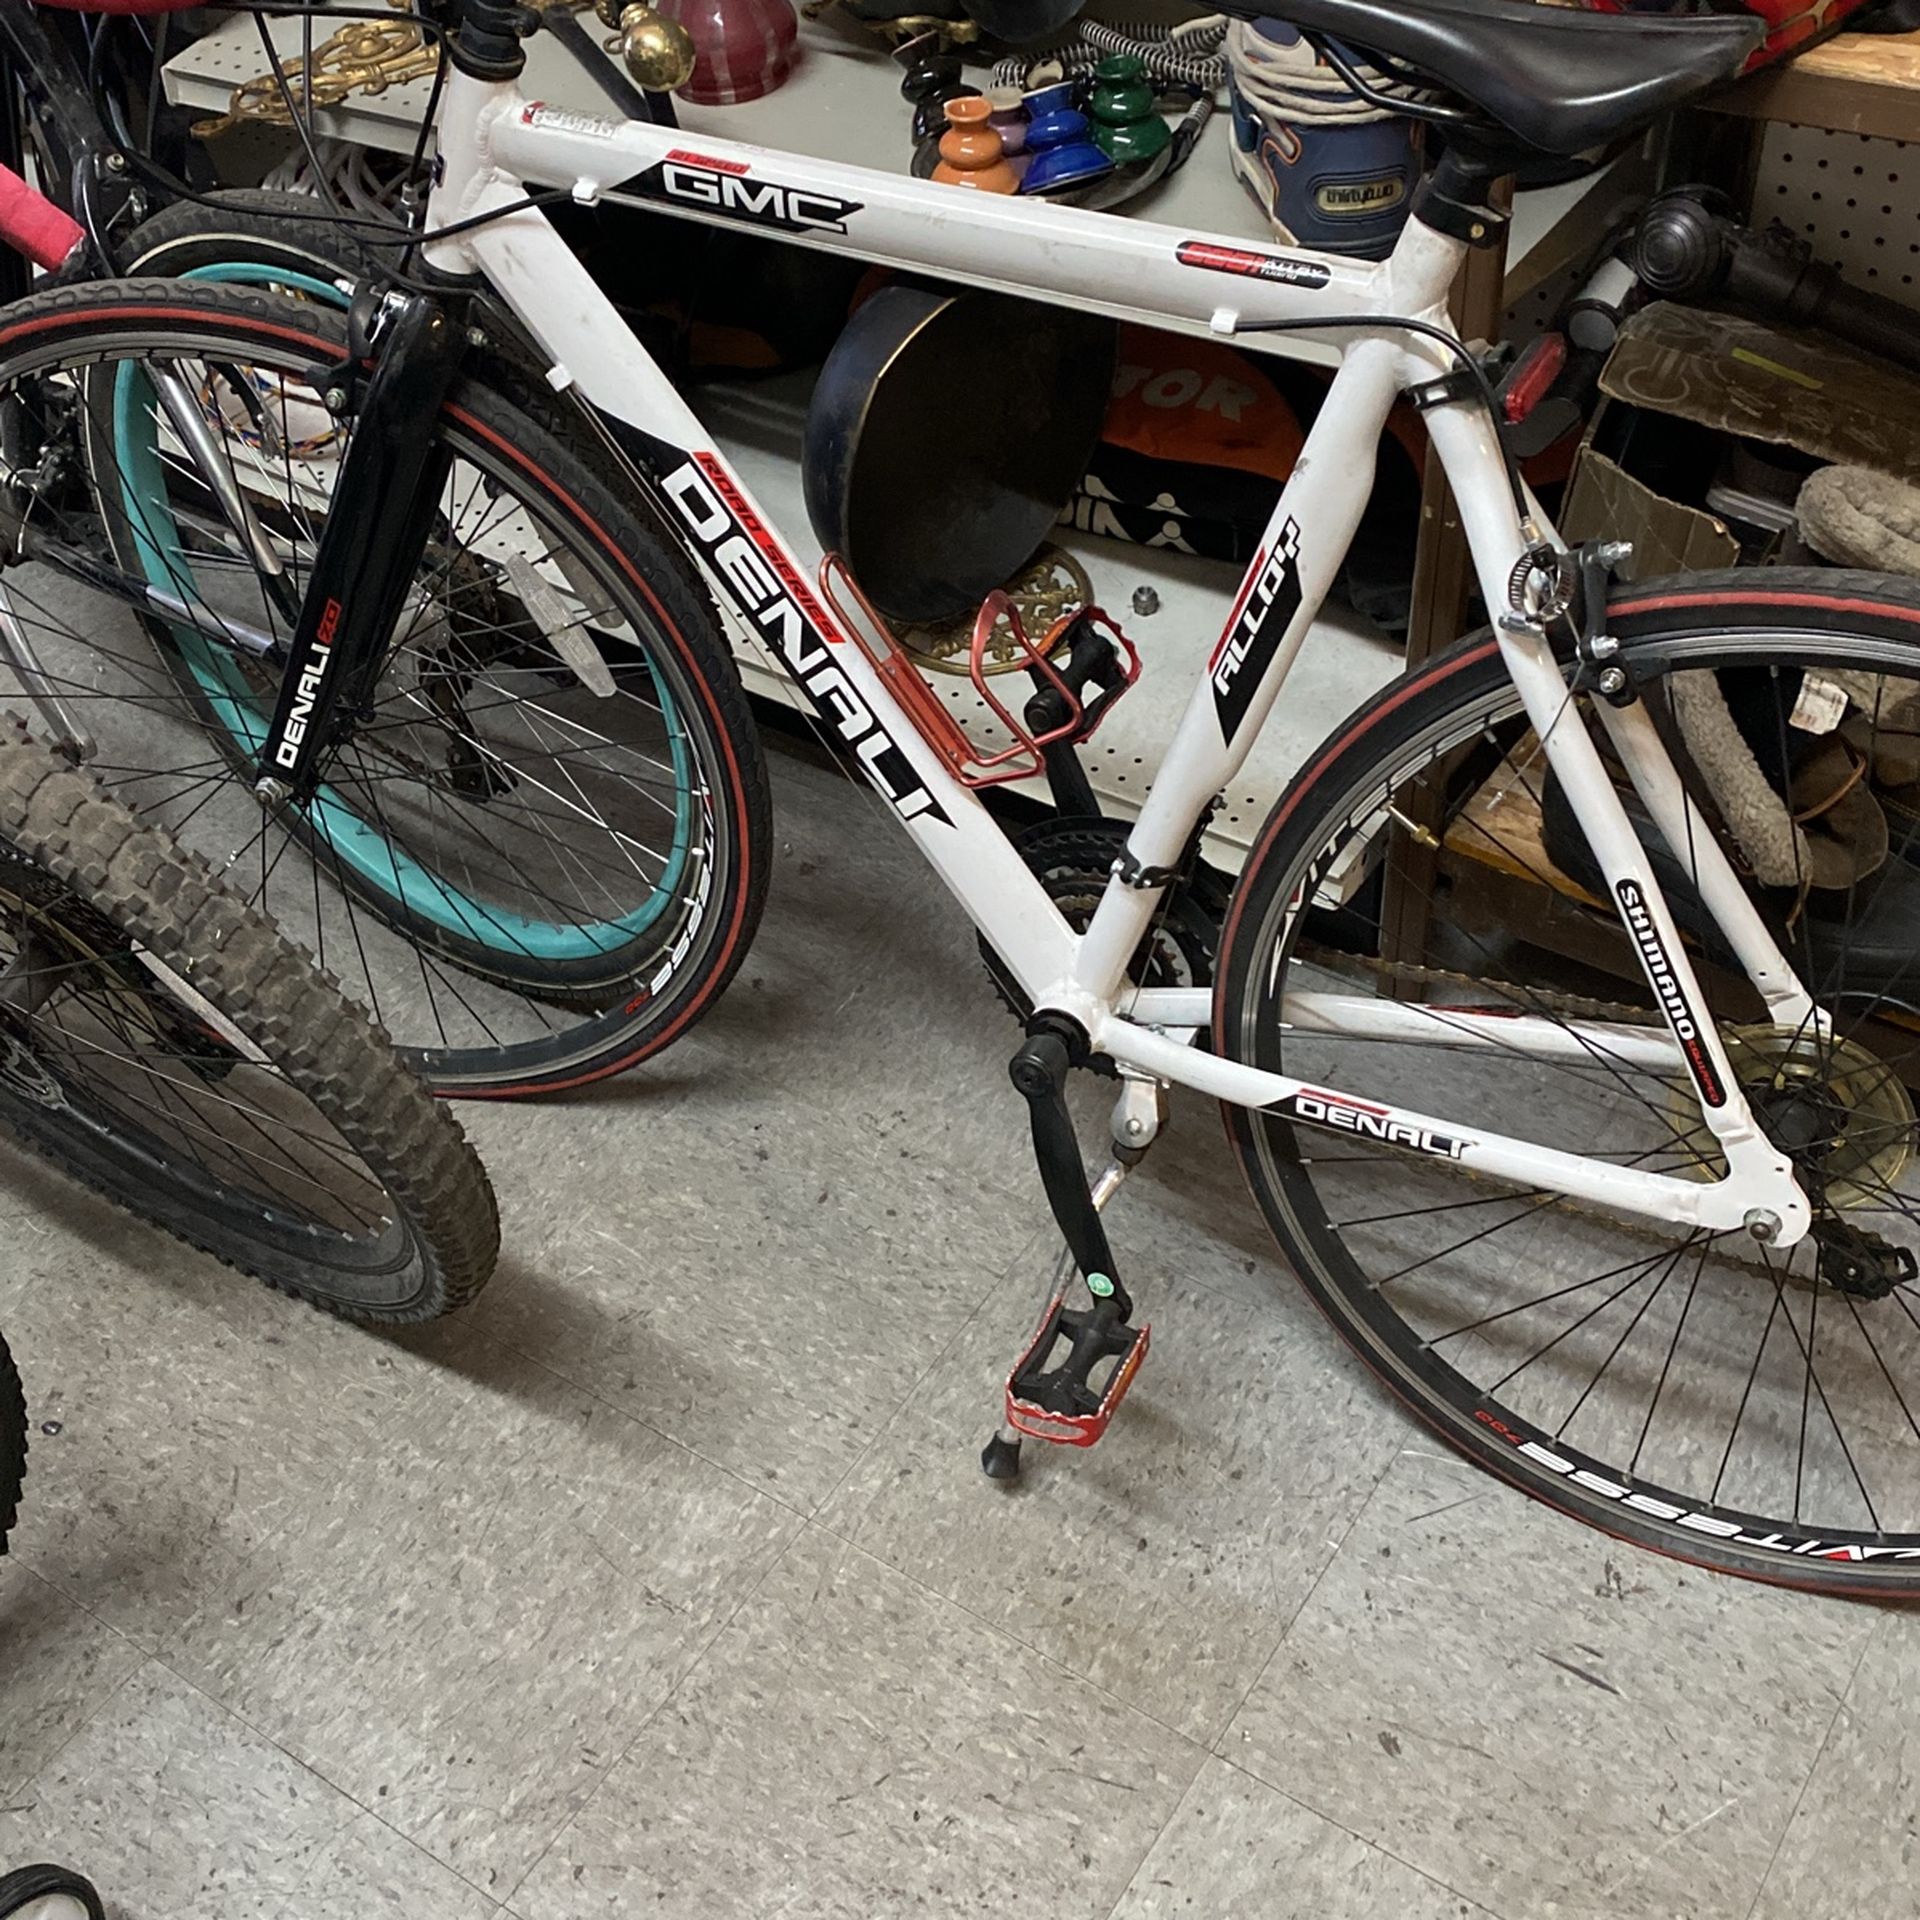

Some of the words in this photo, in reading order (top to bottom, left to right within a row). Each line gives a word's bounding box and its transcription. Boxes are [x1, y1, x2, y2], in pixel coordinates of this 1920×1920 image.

[663, 163, 847, 233] GMC
[702, 456, 762, 534] ROAD
[763, 543, 841, 641] SERIES
[1214, 518, 1299, 697] ALLOY
[276, 642, 331, 769] DENALI
[660, 462, 934, 820] DENALI
[1620, 885, 1696, 1041] SHIMANO
[1295, 1096, 1466, 1160] DENALI
[1517, 1440, 1864, 1562] VITESSE
